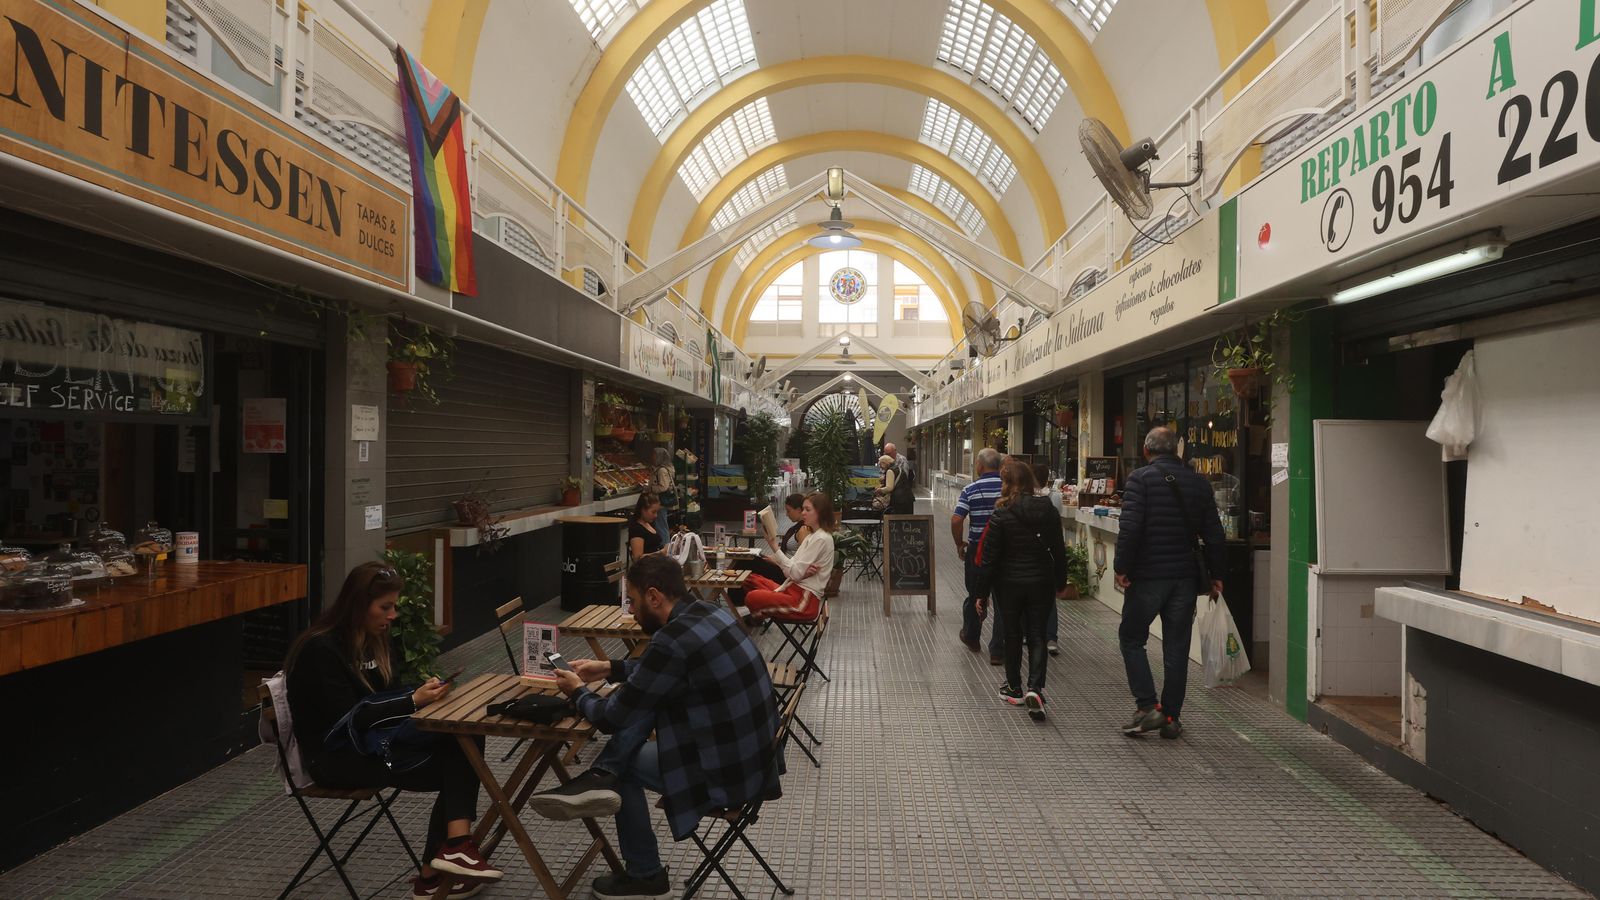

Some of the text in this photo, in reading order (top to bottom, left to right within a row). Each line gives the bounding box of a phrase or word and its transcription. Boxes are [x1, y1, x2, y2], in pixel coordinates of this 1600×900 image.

[1300, 30, 1517, 204] REPARTO A
[1371, 131, 1455, 235] 954
[357, 202, 397, 236] TAPAS &
[359, 228, 395, 257] DULCES
[1115, 258, 1202, 321] infusiones & chocolates
[1128, 262, 1153, 288] especias
[1149, 296, 1175, 325] regalos
[1043, 327, 1053, 357] de
[1054, 321, 1064, 353] la
[1065, 308, 1105, 348] Sultana
[49, 384, 135, 412] SERVICE
